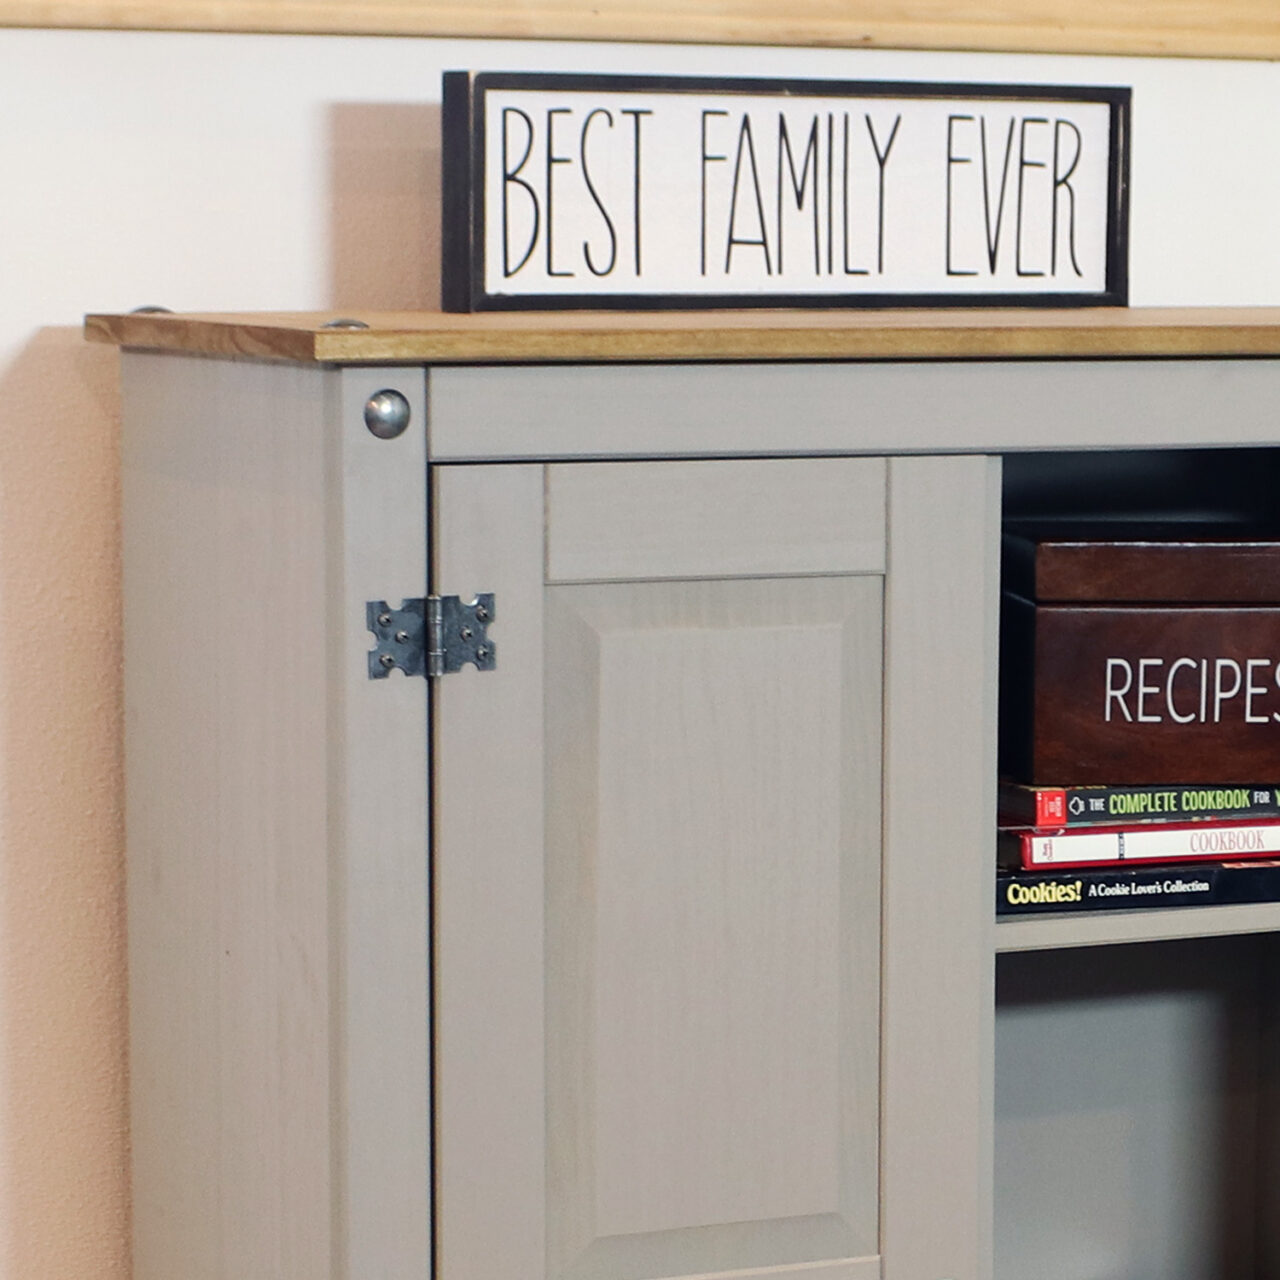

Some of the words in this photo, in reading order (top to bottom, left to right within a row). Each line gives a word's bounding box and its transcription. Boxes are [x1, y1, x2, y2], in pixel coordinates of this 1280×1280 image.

[502, 107, 653, 278] BEST
[701, 109, 901, 277] FAMILY
[946, 114, 1083, 278] EVER
[1089, 798, 1105, 812] THE
[1109, 791, 1178, 815] COMPLETE
[1181, 788, 1251, 812] COOKBOOK
[1253, 790, 1270, 805] FOR
[1189, 830, 1265, 853] COOKBOOK
[1007, 881, 1083, 905] Cookies!
[1088, 885, 1098, 897] A
[1098, 882, 1130, 897] Cookie
[1131, 881, 1162, 896] Lover's
[1163, 879, 1210, 894] Collection
